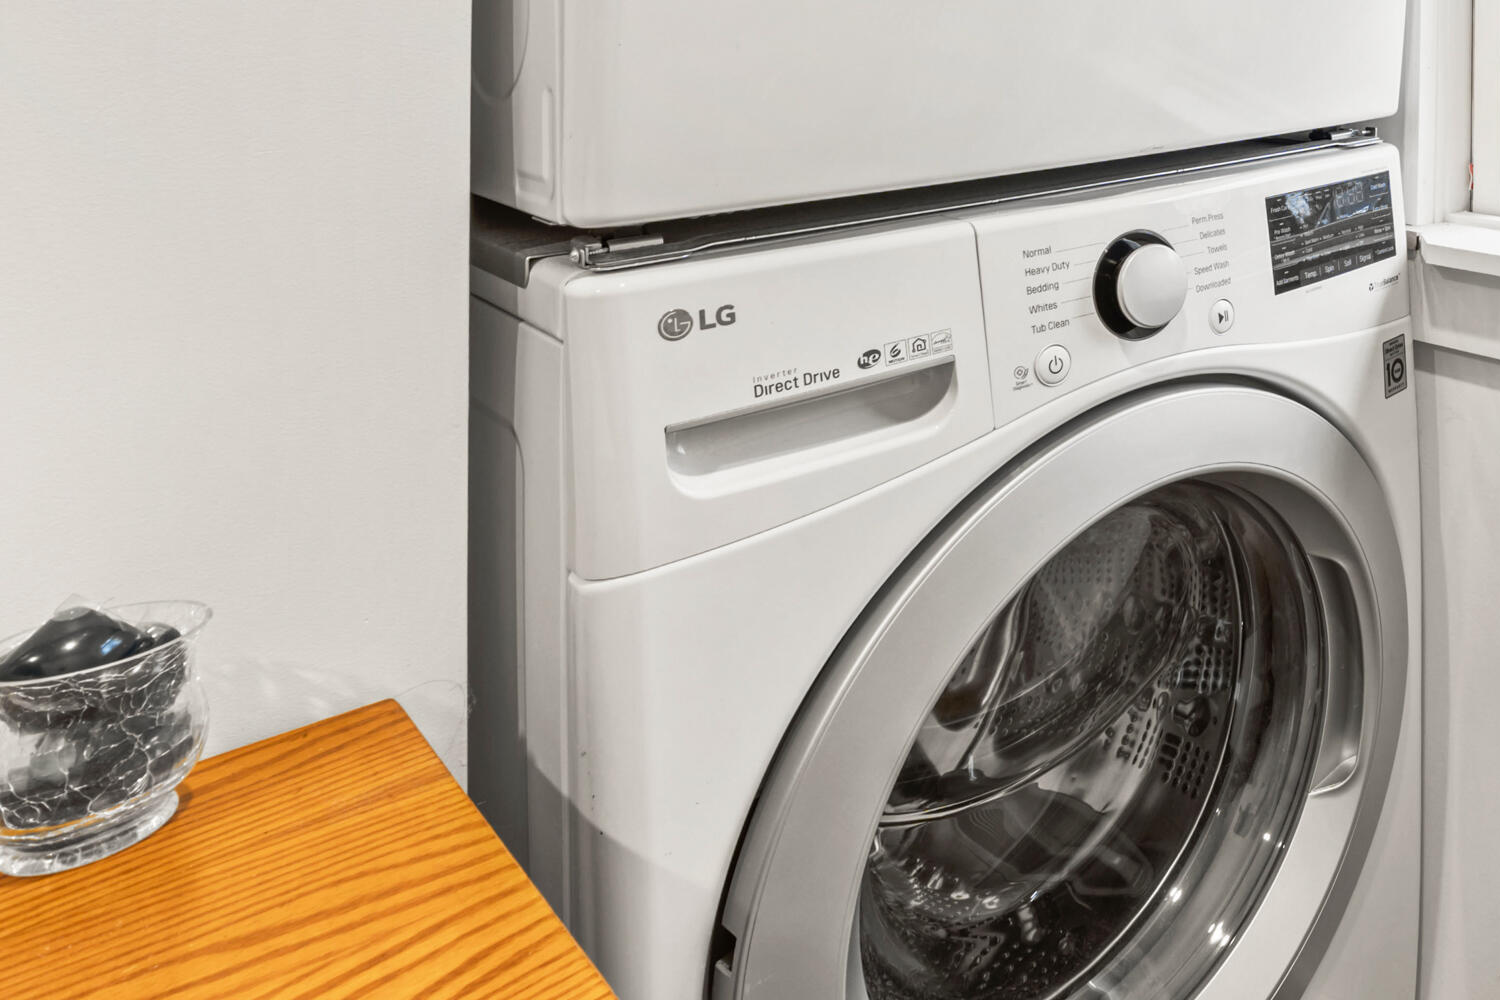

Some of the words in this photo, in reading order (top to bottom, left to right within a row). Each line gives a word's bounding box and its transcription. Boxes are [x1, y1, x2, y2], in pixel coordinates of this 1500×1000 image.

[1199, 228, 1225, 240] Delicates
[1022, 245, 1052, 259] Normal
[1207, 244, 1228, 254] Towels
[1024, 265, 1050, 277] Heavy
[1051, 261, 1070, 272] Duty
[1194, 264, 1213, 275] Speed
[1213, 260, 1230, 270] Wash
[1026, 281, 1060, 296] Bedding
[1195, 277, 1232, 293] Downloaded
[1028, 302, 1058, 315] Whites
[698, 304, 736, 331] LG
[1031, 324, 1047, 335] Tub
[1048, 319, 1070, 331] Clean
[753, 368, 797, 383] Inverter
[754, 377, 799, 398] Direct
[803, 368, 841, 386] Drive
